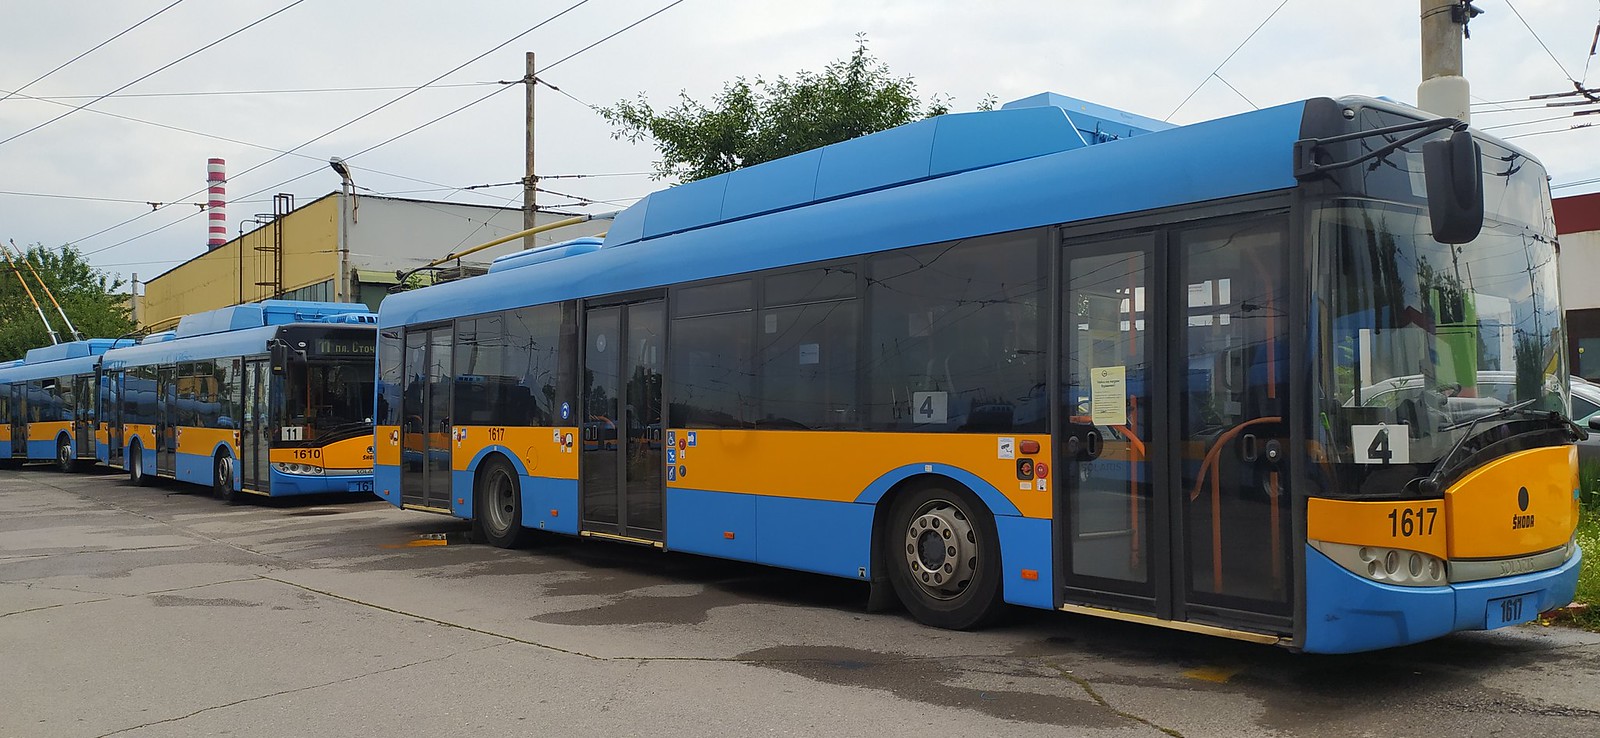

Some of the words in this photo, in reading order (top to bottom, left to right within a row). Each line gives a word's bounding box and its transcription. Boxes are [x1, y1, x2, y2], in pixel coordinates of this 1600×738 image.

[319, 341, 331, 353] 11
[335, 344, 350, 353] пл.
[919, 395, 934, 419] 4
[286, 428, 297, 440] 11
[488, 427, 505, 441] 1617
[1367, 426, 1393, 465] 4
[293, 449, 321, 459] 1610
[1387, 507, 1438, 538] 1617
[1512, 514, 1535, 530] ŠKODA
[1500, 598, 1523, 623] 1617
